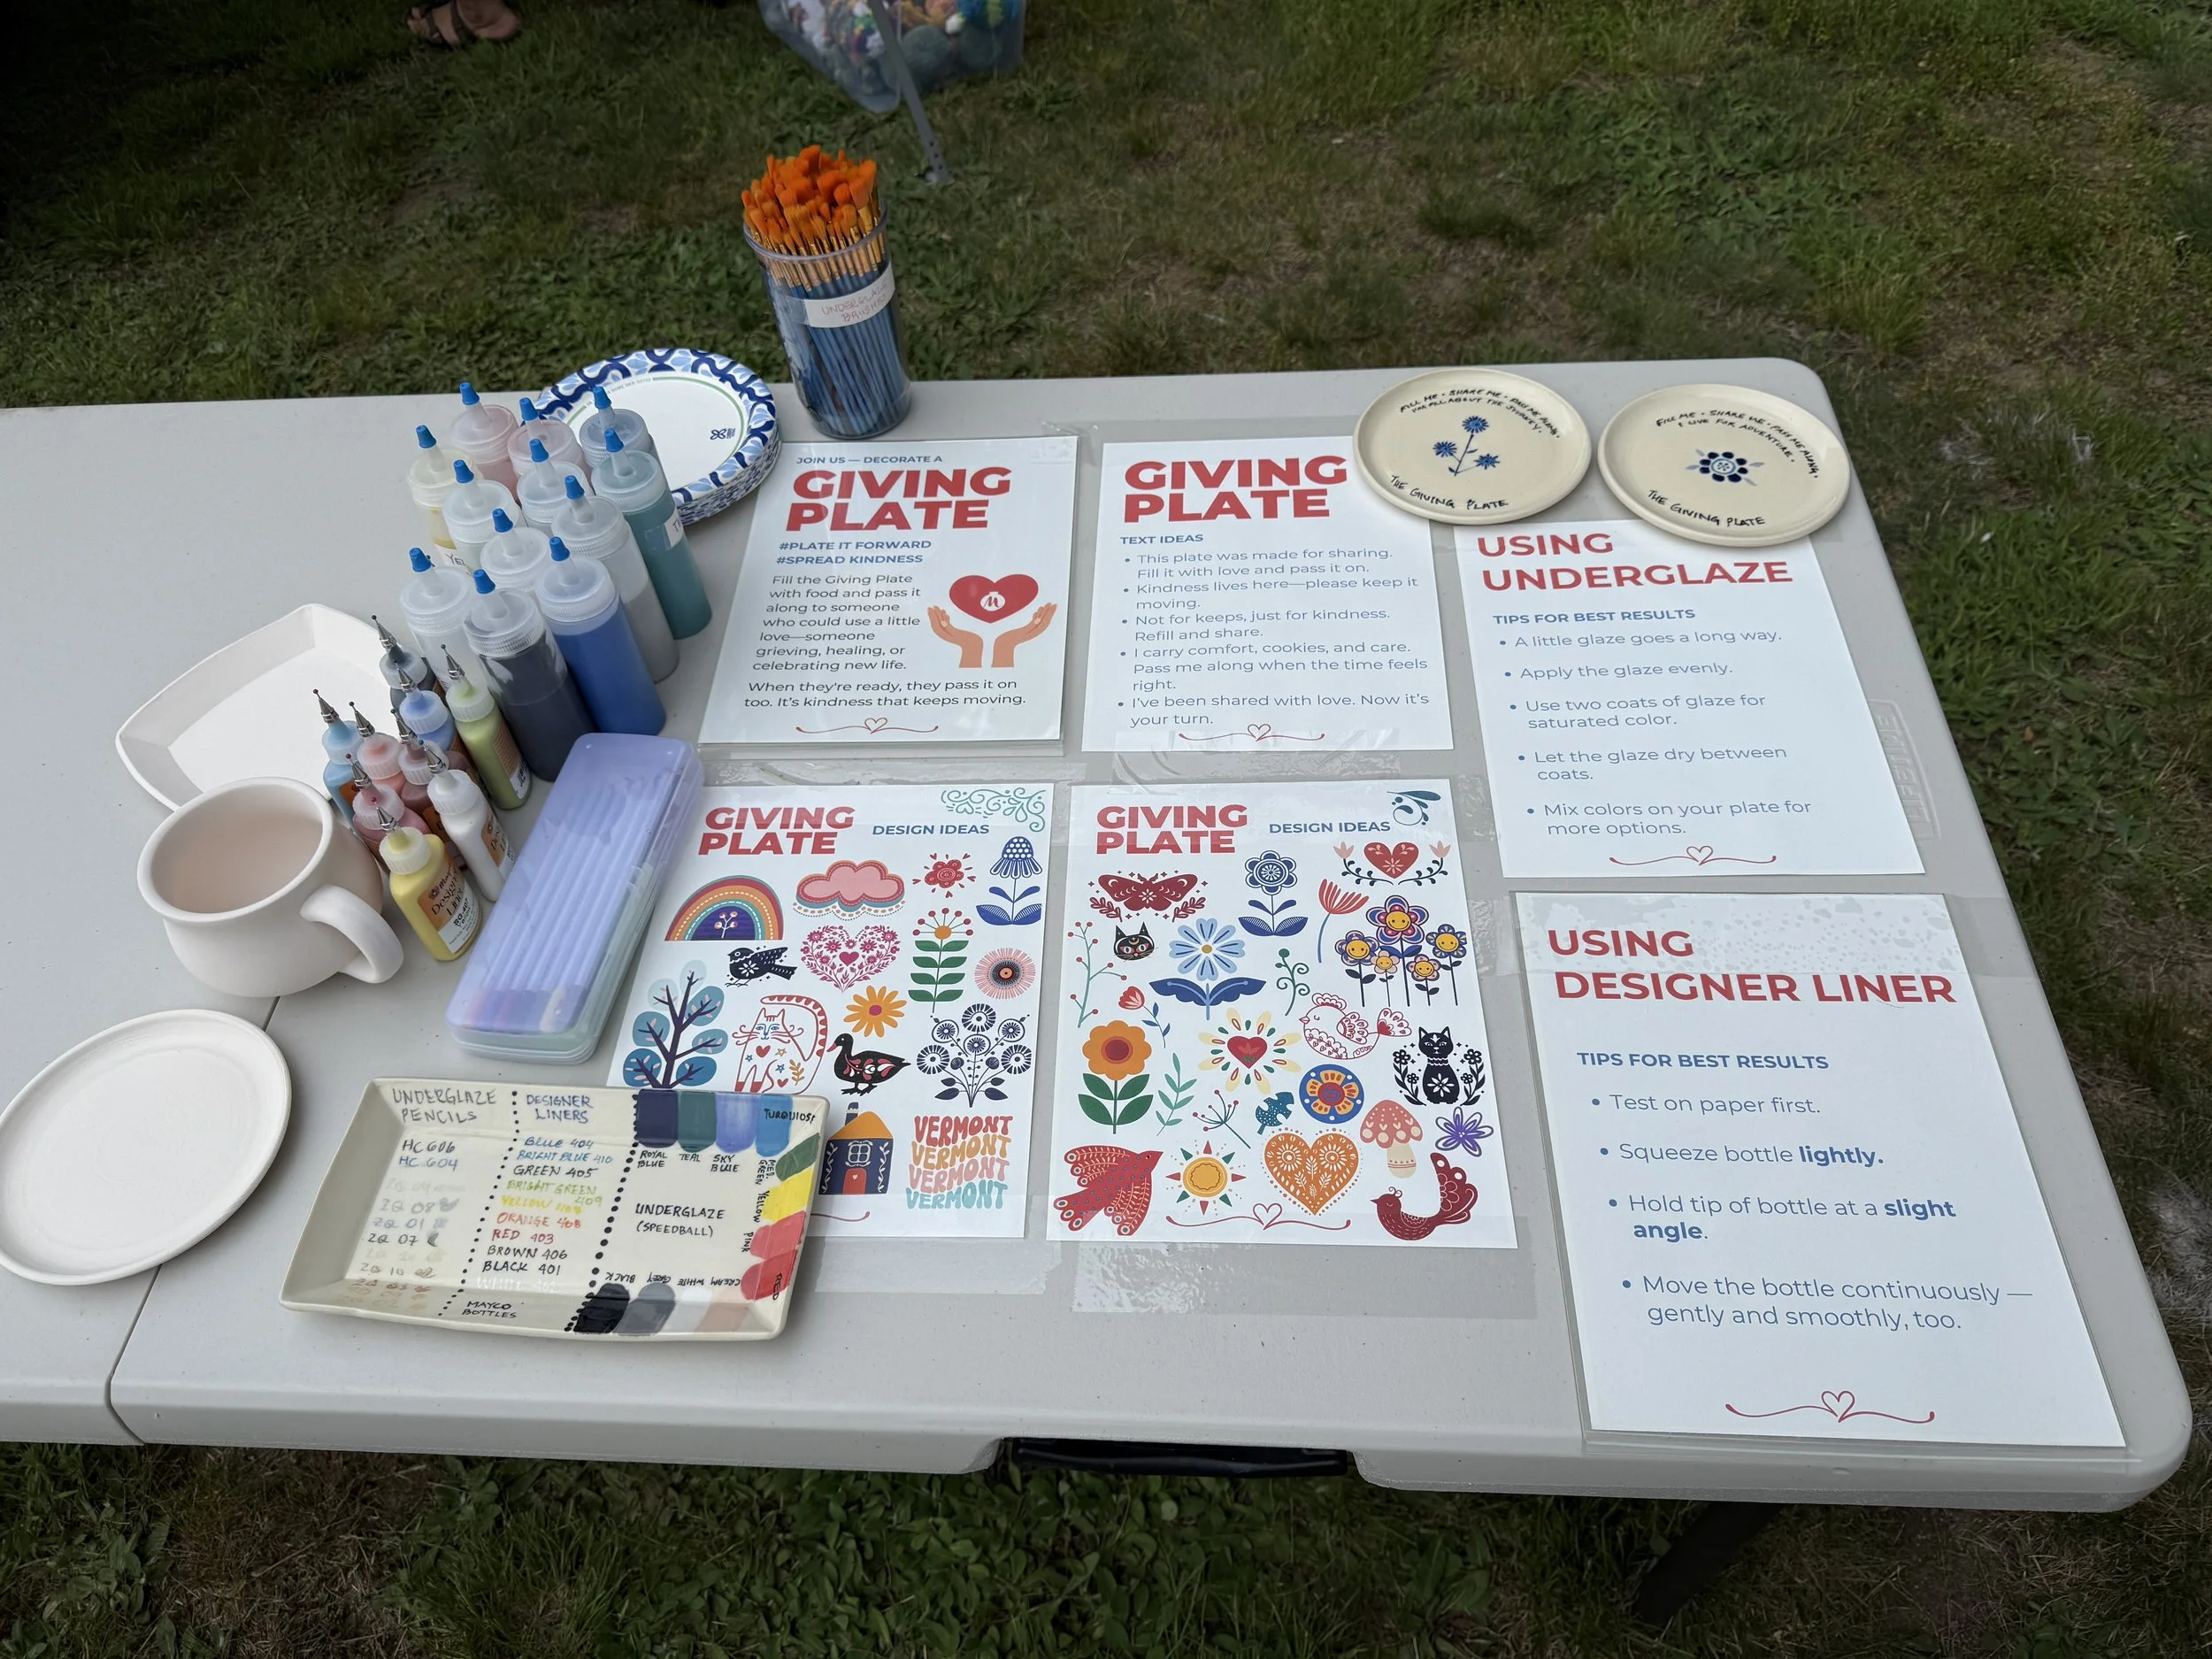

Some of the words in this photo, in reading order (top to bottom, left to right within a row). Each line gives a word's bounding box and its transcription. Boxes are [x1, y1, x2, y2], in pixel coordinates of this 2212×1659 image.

[1717, 419, 1734, 427] FOR
[1125, 456, 1347, 489] GIVING
[794, 467, 1011, 499] GIVING
[1391, 475, 1408, 490] THE
[1410, 488, 1455, 508] GIVING
[1467, 499, 1509, 510] PLATE
[1125, 489, 1329, 523] PLATE
[1647, 490, 1668, 504] THE
[1671, 503, 1719, 526] GIVING
[1727, 518, 1765, 526] PLATE
[787, 500, 989, 531] PLATE
[856, 541, 931, 549] FORWARD
[1160, 534, 1203, 543] IDEAS
[1478, 533, 1613, 557] USING
[849, 555, 923, 564] KINDNESS
[797, 575, 821, 584] the
[826, 575, 871, 586] Giving
[1482, 562, 1793, 591] UNDERGLAZE
[1138, 583, 1209, 594] Kindness
[1214, 581, 1248, 591] lives
[1253, 579, 1357, 590] here—please
[1363, 578, 1402, 588] keep
[1408, 577, 1417, 586] it
[766, 603, 807, 614] along
[1137, 598, 1200, 610] moving.
[1136, 616, 1164, 626] Not
[1169, 614, 1191, 624] for
[1196, 613, 1246, 624] keeps,
[1249, 611, 1281, 623] just
[1285, 611, 1308, 620] for
[1313, 610, 1389, 619] kindness.
[1493, 615, 1530, 624] TIPS
[1534, 614, 1569, 623] FOR
[1574, 612, 1616, 622] BEST
[1621, 610, 1695, 620] RESULTS
[1136, 631, 1173, 641] Refill
[1179, 628, 1209, 640] and
[1215, 627, 1263, 638] share.
[757, 647, 821, 657] grieving,
[826, 646, 885, 657] healing,
[1135, 649, 1137, 657] I
[1143, 649, 1184, 658] carry
[1188, 645, 1257, 656] comfort,
[1263, 643, 1328, 654] cookies,
[1333, 642, 1364, 652] and
[753, 661, 840, 672] celebrating
[881, 660, 906, 669] life.
[1520, 666, 1572, 680] Apply
[1578, 665, 1609, 677] the
[1614, 664, 1663, 678] glaze
[1669, 663, 1732, 675] evenly.
[778, 697, 799, 706] It’s
[803, 697, 872, 706] kindness
[877, 696, 909, 706] that
[914, 696, 959, 707] keeps
[964, 695, 1025, 705] moving.
[1535, 752, 1564, 763] Let
[1569, 750, 1602, 763] the
[1608, 749, 1659, 764] glaze
[1664, 749, 1694, 762] dry
[1701, 749, 1786, 759] between
[1538, 769, 1593, 780] coats.
[704, 807, 855, 829] GIVING
[1096, 804, 1248, 829] GIVING
[872, 826, 934, 834] DESIGN
[940, 825, 989, 834] IDEAS
[1270, 823, 1333, 833] DESIGN
[1339, 822, 1390, 832] IDEAS
[698, 832, 837, 855] PLATE
[1096, 831, 1235, 854] PLATE
[1548, 929, 1694, 956] USING
[1555, 972, 1800, 1001] DESIGNER
[1814, 974, 1956, 1003] LINER
[393, 1088, 496, 1104] UNDERGLAZE
[526, 1094, 594, 1108] DESIGNER
[1609, 1094, 1658, 1110] Test
[1664, 1099, 1692, 1110] on
[1701, 1100, 1764, 1115] paper
[1770, 1097, 1820, 1112] first.
[402, 1108, 477, 1124] PENCILS
[535, 1109, 588, 1124] LINERS
[914, 1116, 1013, 1147] VERMONT
[559, 1152, 591, 1162] BLUE
[640, 1150, 668, 1159] ROYAL
[911, 1133, 1011, 1170] VERMONT
[1620, 1144, 1717, 1164] Squeeze
[1724, 1146, 1793, 1162] bottle
[1799, 1146, 1883, 1167] lightly.
[513, 1165, 561, 1176] GREEN
[565, 1168, 598, 1178] 405
[909, 1156, 1010, 1194] VERMONT
[906, 1179, 1008, 1209] VERMONT
[635, 1203, 726, 1219] UNDERGLAZE
[753, 1190, 770, 1223] YELLOW
[1630, 1195, 1683, 1212] Hold
[1690, 1196, 1722, 1217] tip
[1729, 1197, 1751, 1213] of
[1757, 1197, 1827, 1215] bottle
[1835, 1201, 1858, 1215] at
[1865, 1203, 1878, 1216] a
[1884, 1198, 1956, 1220] slight
[492, 1229, 520, 1241] RED
[531, 1233, 554, 1244] 403
[636, 1220, 714, 1238] (SPEEDBALL)
[1634, 1223, 1708, 1242] angle.
[741, 1232, 754, 1252] PINK
[488, 1245, 538, 1258] BROWN
[541, 1249, 567, 1260] 406
[482, 1261, 528, 1272] BLACK
[539, 1263, 561, 1276] 401
[605, 1271, 636, 1283] BLACK
[710, 1277, 741, 1286] CREAM
[772, 1272, 783, 1300] RED
[462, 1309, 517, 1318] BOTTLES
[467, 1301, 511, 1310] MAYCO
[1648, 1305, 1724, 1326] gently
[1732, 1306, 1778, 1324] and
[1786, 1308, 1908, 1331] smoothly,
[1913, 1311, 1961, 1328] too.
